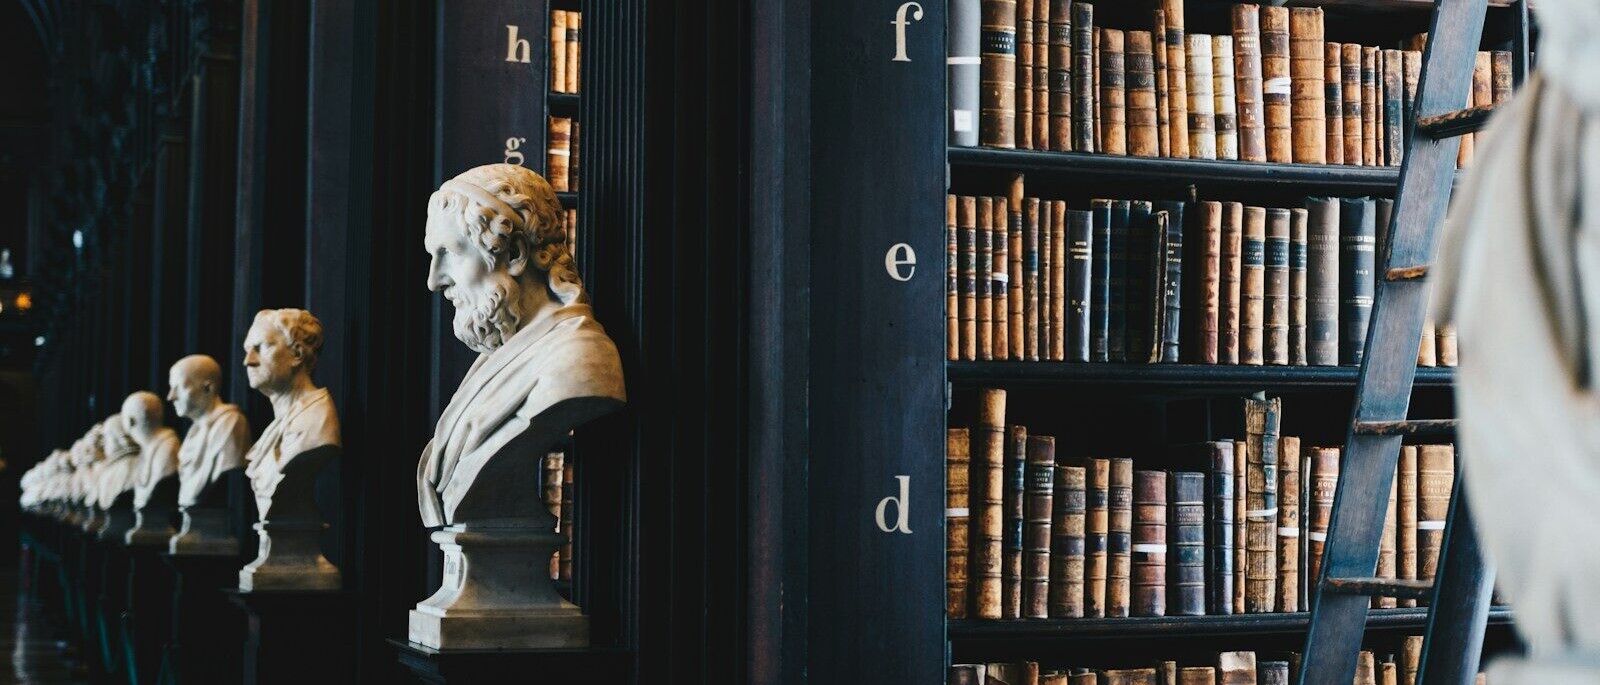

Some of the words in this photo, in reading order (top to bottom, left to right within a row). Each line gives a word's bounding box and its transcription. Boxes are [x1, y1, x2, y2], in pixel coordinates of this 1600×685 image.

[505, 24, 531, 64] h
[890, 1, 924, 62] f
[504, 136, 526, 165] g
[884, 242, 917, 282] e
[875, 475, 913, 534] d
[1313, 490, 1335, 498] BIBL
